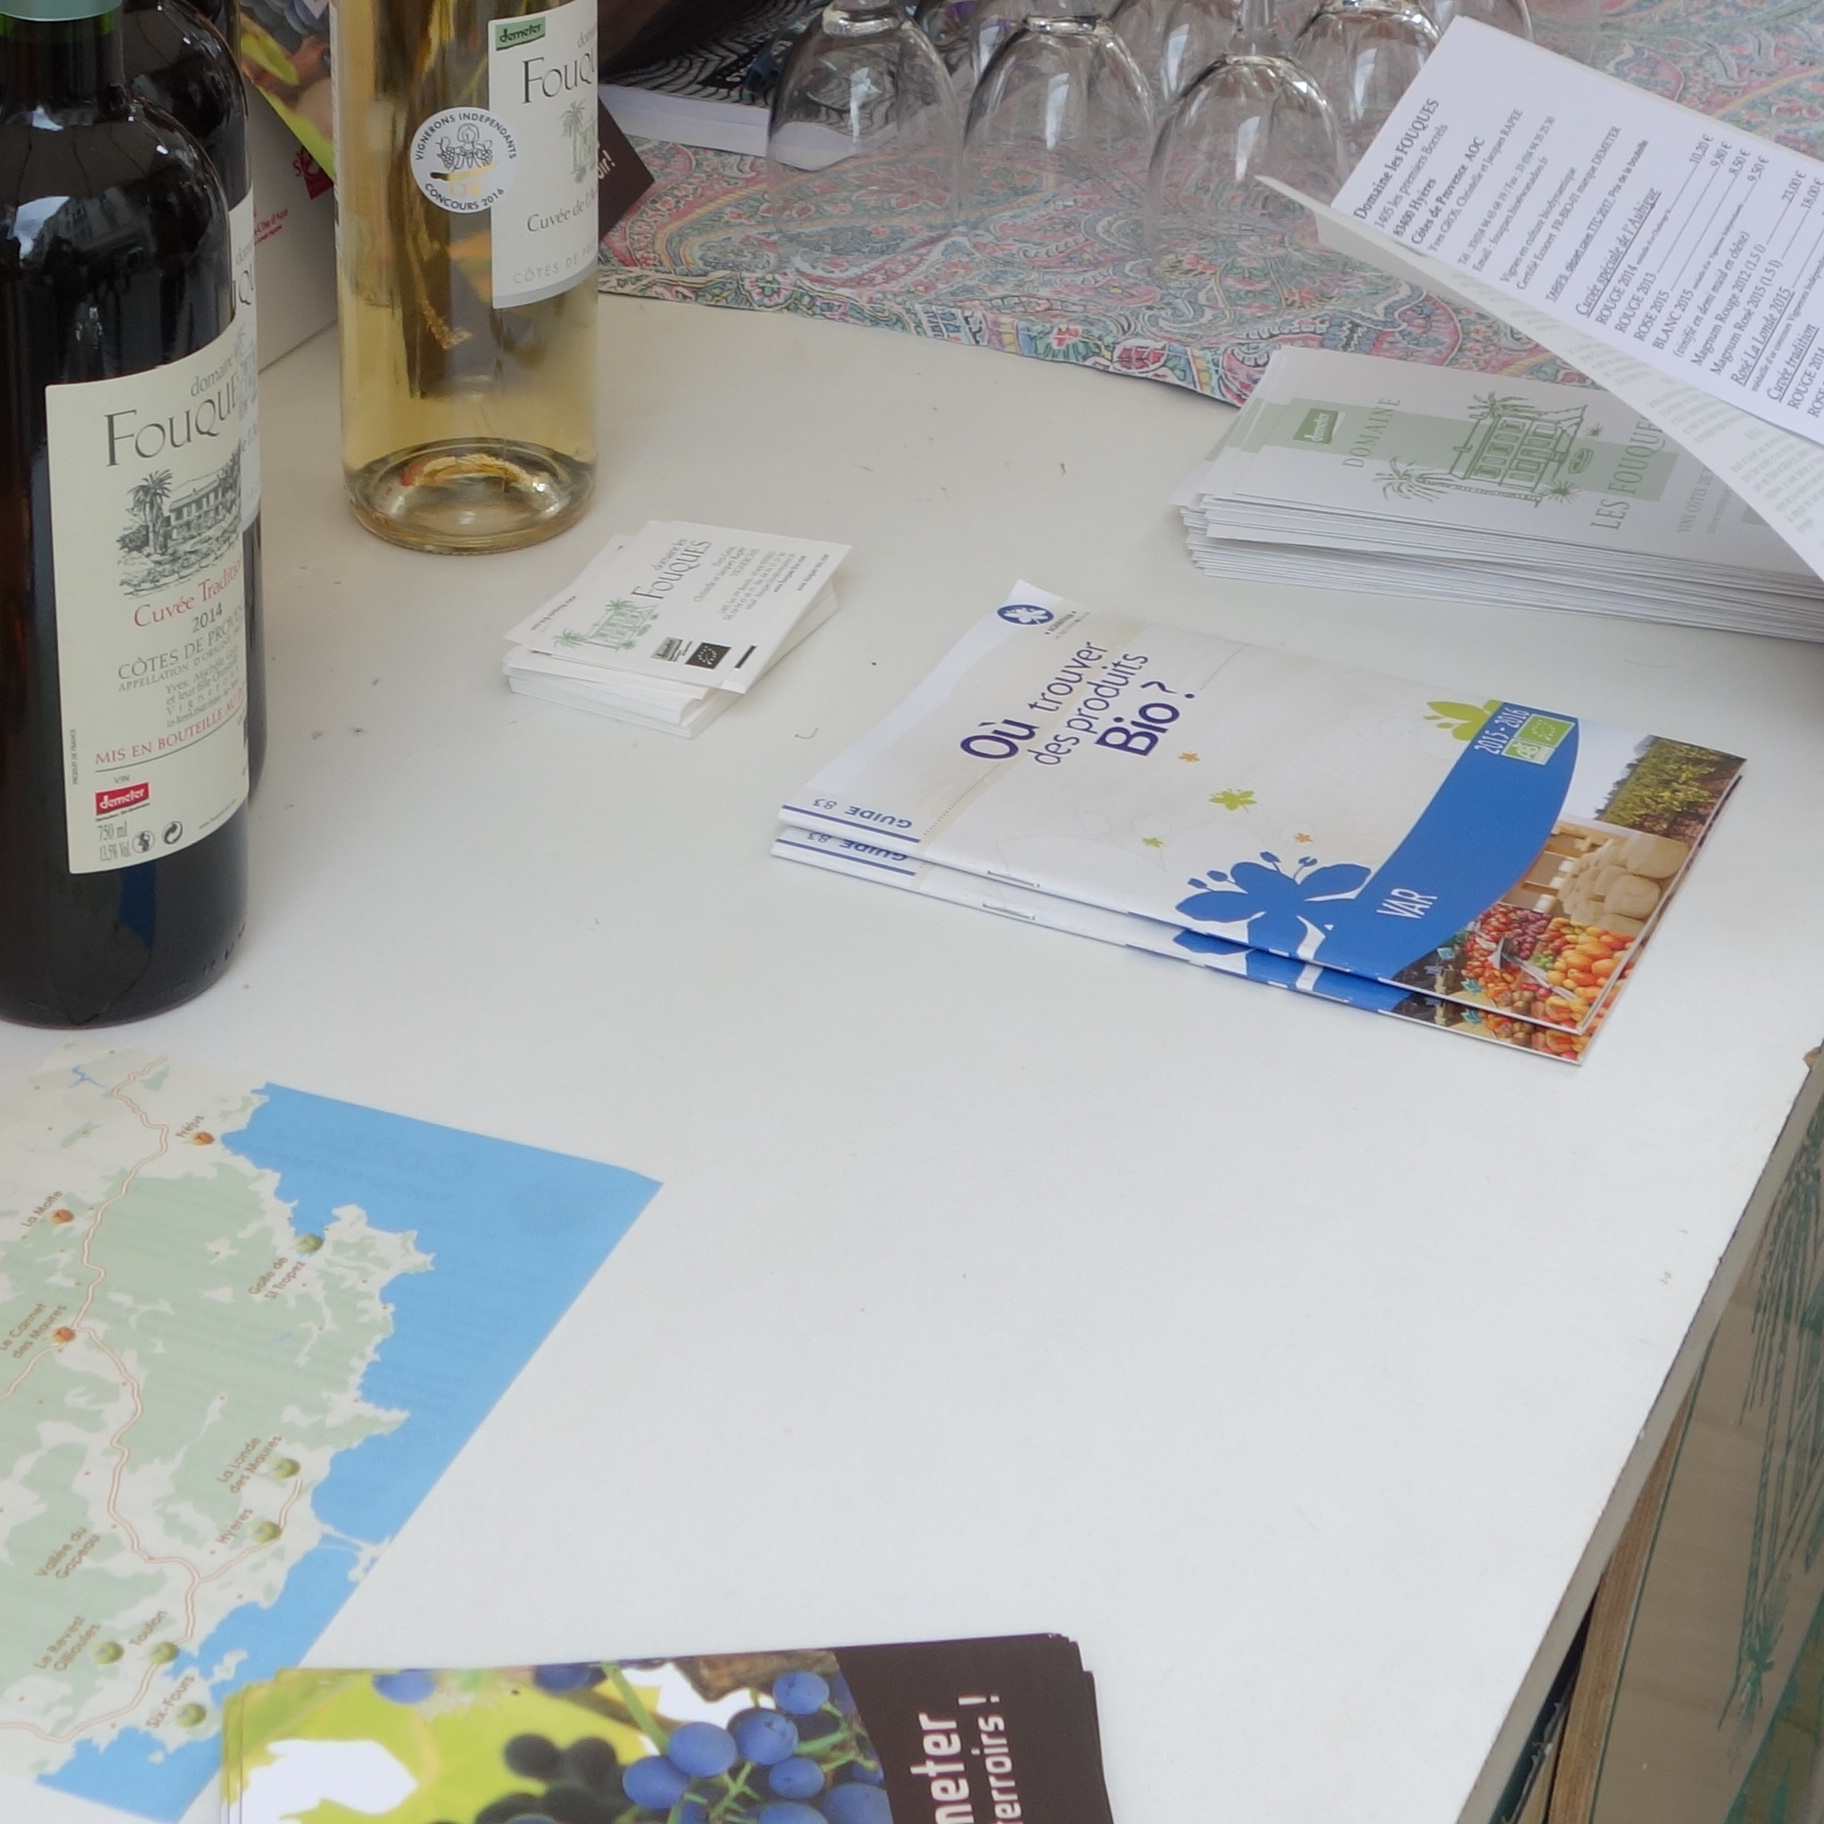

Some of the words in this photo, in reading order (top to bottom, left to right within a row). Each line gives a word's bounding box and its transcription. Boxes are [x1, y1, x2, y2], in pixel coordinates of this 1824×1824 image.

[498, 22, 544, 44] demeter
[415, 113, 455, 161] VIGNERONS
[459, 112, 517, 160] INDEPENDANTS
[1354, 172, 1392, 219] Domaine
[1385, 156, 1403, 171] les
[1396, 99, 1439, 155] FOUQUES
[424, 182, 480, 211] CONCOURS
[481, 187, 505, 207] 2016
[1411, 219, 1434, 244] Côtes
[1429, 206, 1442, 218] de
[1436, 164, 1468, 205] Provence
[1465, 137, 1484, 161] AOC
[526, 207, 571, 233] Cuvée
[1595, 286, 1625, 325] ROUGE
[1618, 264, 1638, 287] 2014
[1689, 141, 1709, 164] 10,20
[1576, 284, 1604, 318] Cuvée
[1597, 250, 1625, 286] spéciale
[1616, 235, 1632, 248] de
[1691, 324, 1722, 366] Magnum
[1715, 293, 1740, 323] Rouge
[1732, 271, 1751, 293] 2012
[1782, 178, 1802, 203] 23,00
[1614, 294, 1644, 333] ROUGE
[1637, 272, 1656, 295] 2013
[1633, 312, 1657, 341] ROSE
[1650, 290, 1669, 313] 2015
[1653, 311, 1681, 349] BLANC
[1674, 289, 1693, 312] 2015
[1710, 333, 1741, 375] Magnum
[1734, 308, 1754, 331] Rosé
[1747, 286, 1766, 308] 2015
[1730, 358, 1754, 385] Rosé
[1744, 345, 1760, 360] La
[1752, 314, 1777, 346] Londe
[1769, 286, 1793, 314] 2015
[1767, 368, 1793, 401] Cuvée
[1785, 324, 1818, 370] tradition
[1787, 369, 1816, 409] ROUGE
[1305, 413, 1327, 441] demeter
[1342, 399, 1400, 467] DOMAINE
[1590, 500, 1629, 529] LES
[631, 542, 709, 599] FOUQUES
[132, 595, 196, 628] Cuvée
[192, 602, 223, 634] 2014
[117, 649, 180, 680] CÔTES
[184, 636, 204, 661] DE
[960, 719, 1039, 759] Où
[1028, 642, 1107, 711] trouver
[1027, 735, 1080, 765] des
[1067, 654, 1148, 734] produits
[1095, 703, 1179, 756] Bio
[1141, 681, 1194, 698] ?
[94, 747, 127, 766] MIS
[131, 741, 153, 758] EN
[156, 706, 224, 751] BOUTEILLE
[1474, 729, 1510, 756] 2015
[99, 787, 146, 810] demeter
[113, 774, 131, 784] VIN
[812, 797, 838, 810] 83
[844, 805, 913, 829] GUIDE
[1376, 888, 1438, 919] VAR
[176, 1116, 204, 1137] Fréjus
[248, 1271, 275, 1294] Golfe
[273, 1261, 305, 1289] Tropez
[9, 1303, 46, 1337] Cannet
[13, 1341, 33, 1358] des
[29, 1306, 66, 1339] Maures
[229, 1438, 261, 1468] Londe
[230, 1475, 250, 1493] des
[245, 1437, 282, 1473] Maures
[216, 1509, 253, 1544] Hyères
[36, 1544, 72, 1576] Vallée
[71, 1527, 87, 1541] du
[55, 1535, 100, 1579] Gapeau
[47, 1616, 85, 1653] Revest
[130, 1611, 167, 1644] Toulon
[146, 1676, 195, 1728] Six-Fours
